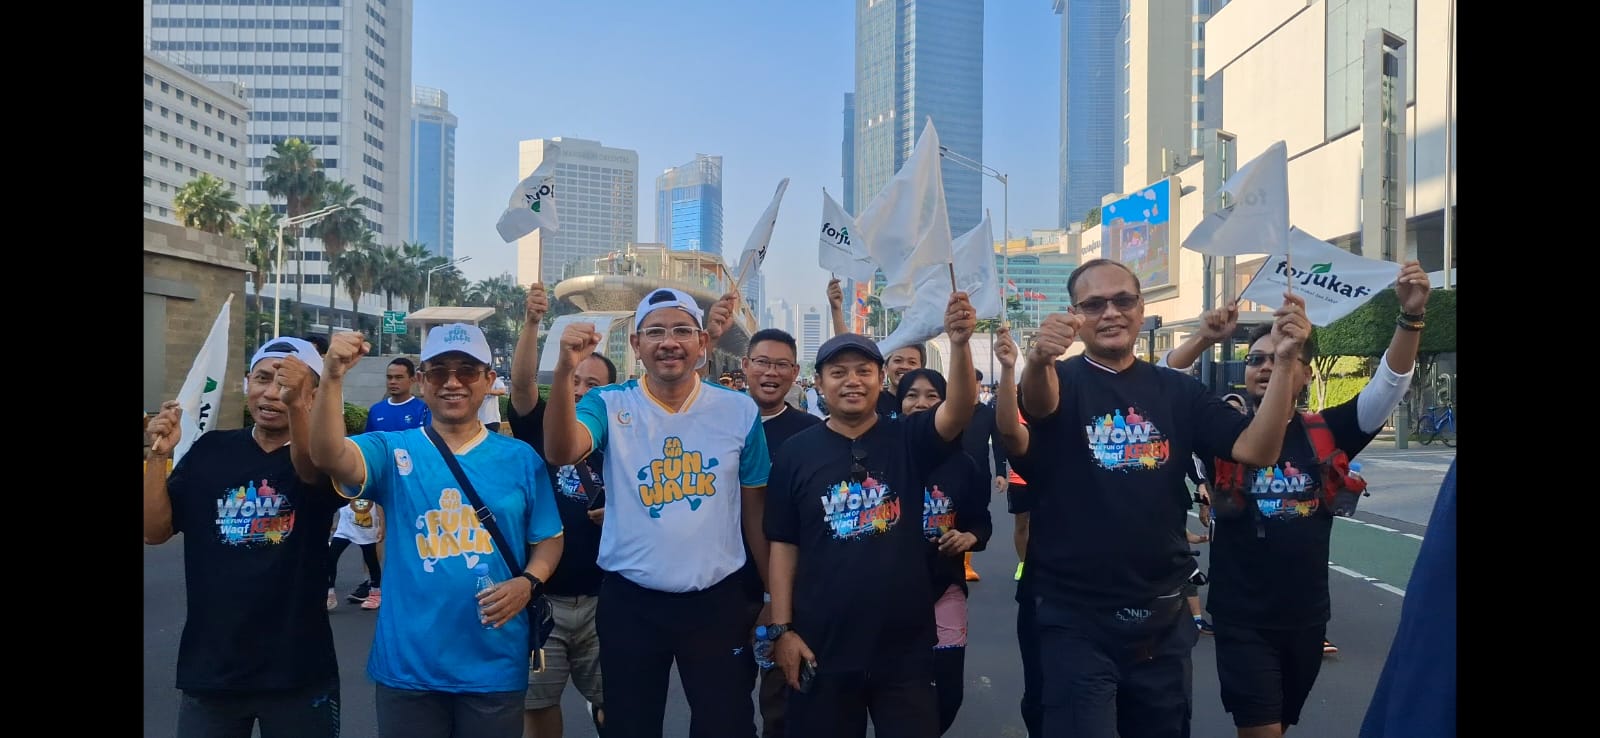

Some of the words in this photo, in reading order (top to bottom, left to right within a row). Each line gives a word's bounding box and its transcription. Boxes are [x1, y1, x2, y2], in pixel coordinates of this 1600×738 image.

[650, 451, 702, 483] FUN
[639, 472, 716, 507] WALK
[416, 527, 494, 559] WALK
